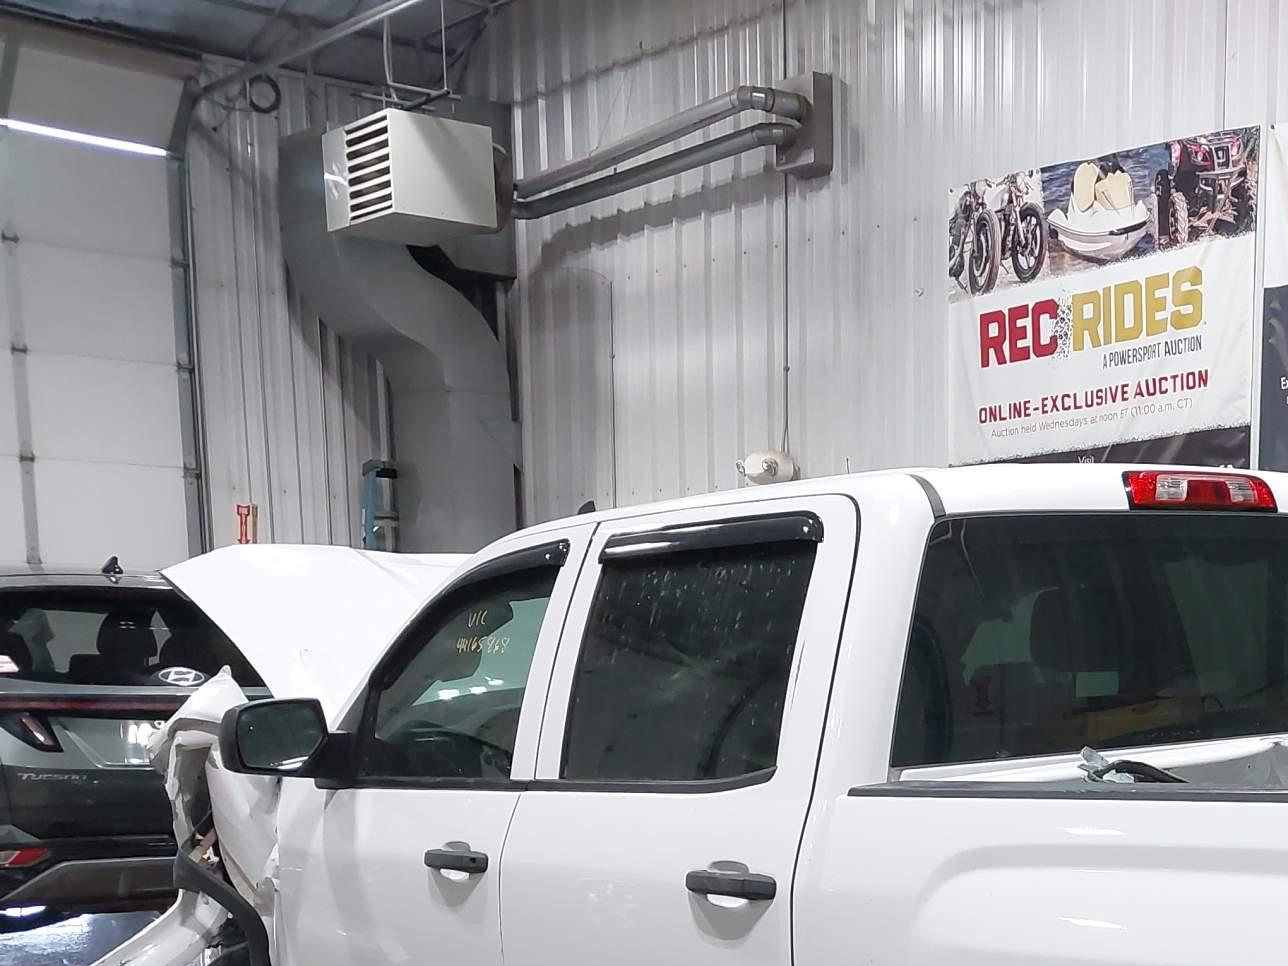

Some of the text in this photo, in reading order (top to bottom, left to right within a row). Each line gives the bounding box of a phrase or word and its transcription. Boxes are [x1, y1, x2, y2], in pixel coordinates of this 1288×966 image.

[980, 265, 1203, 368] REC RIDES
[1103, 335, 1202, 370] A POWERSPORT AUCTION
[979, 369, 1209, 424] ONLINE-EXCLUSIVE AUCTION
[991, 426, 1019, 438] Auction
[1021, 422, 1036, 434] held
[1039, 416, 1087, 431] Wednesdays
